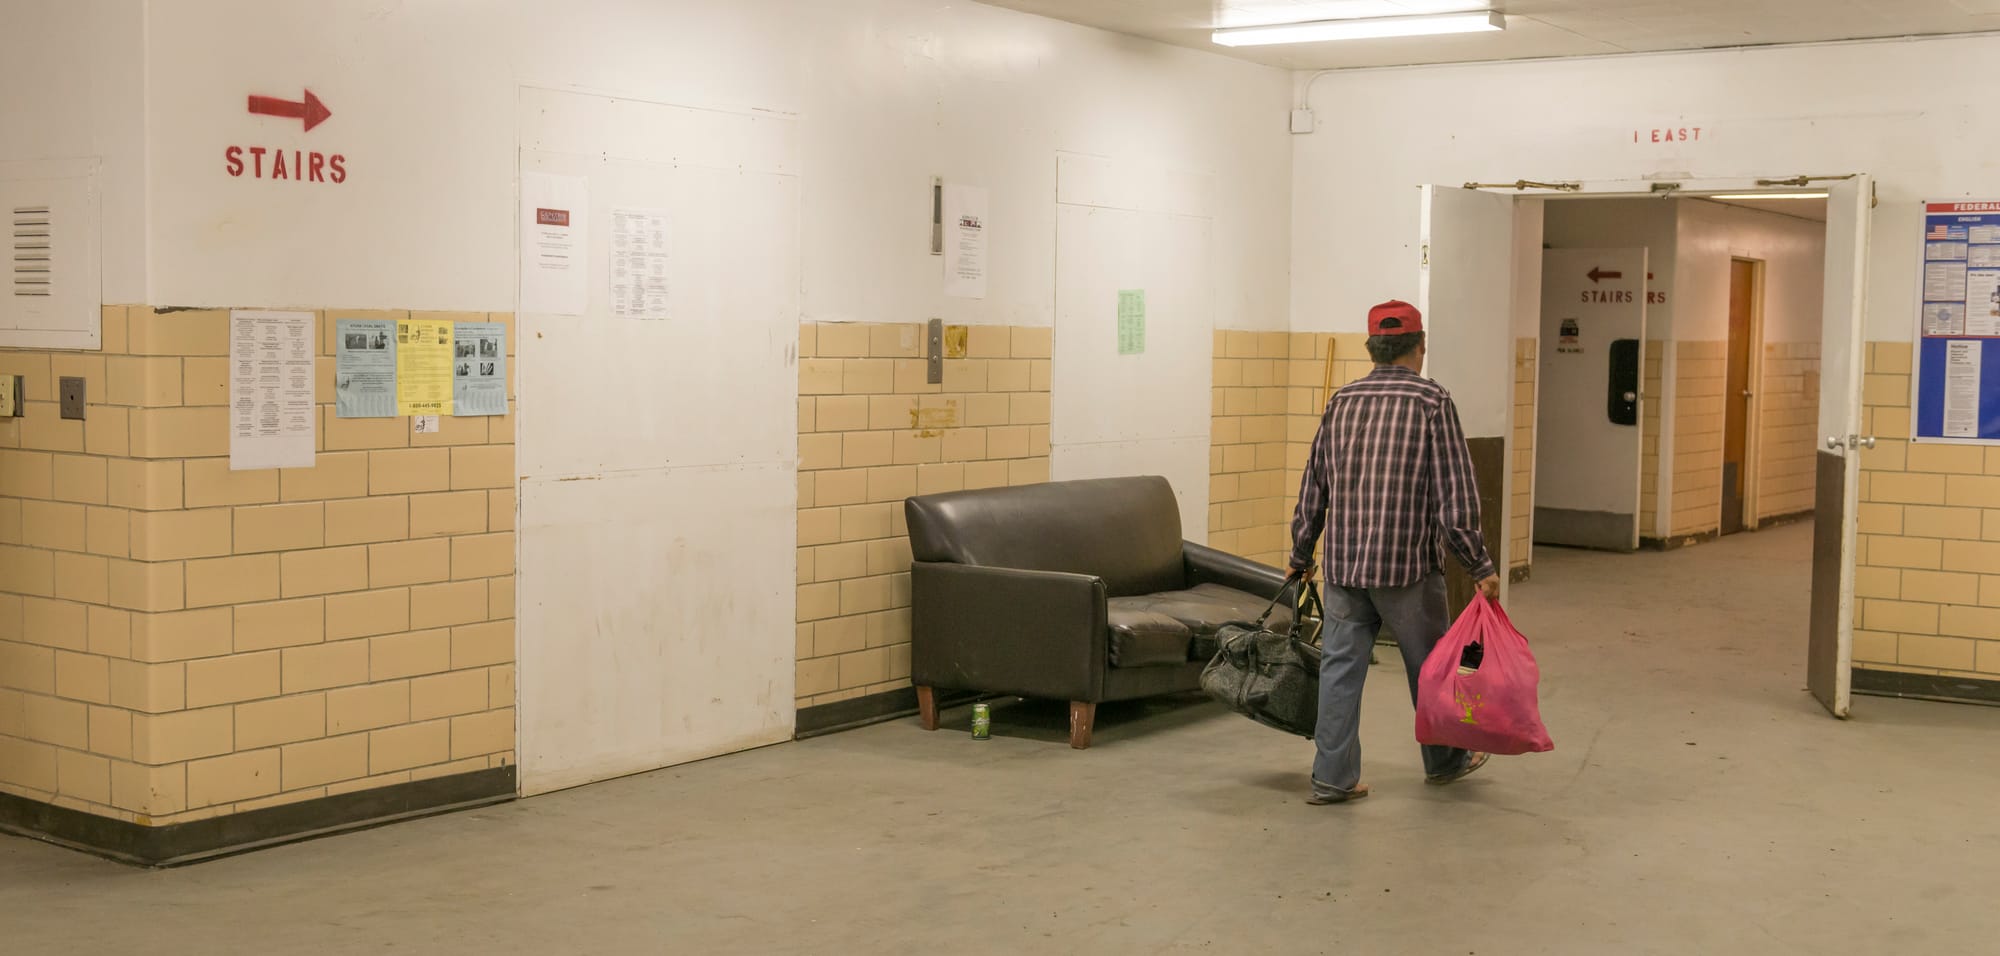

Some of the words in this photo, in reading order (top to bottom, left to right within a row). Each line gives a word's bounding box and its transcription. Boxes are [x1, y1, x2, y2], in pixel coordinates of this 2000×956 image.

[1651, 127, 1701, 143] EAST
[225, 145, 347, 184] STAIRS
[1581, 290, 1633, 304] STAIRS
